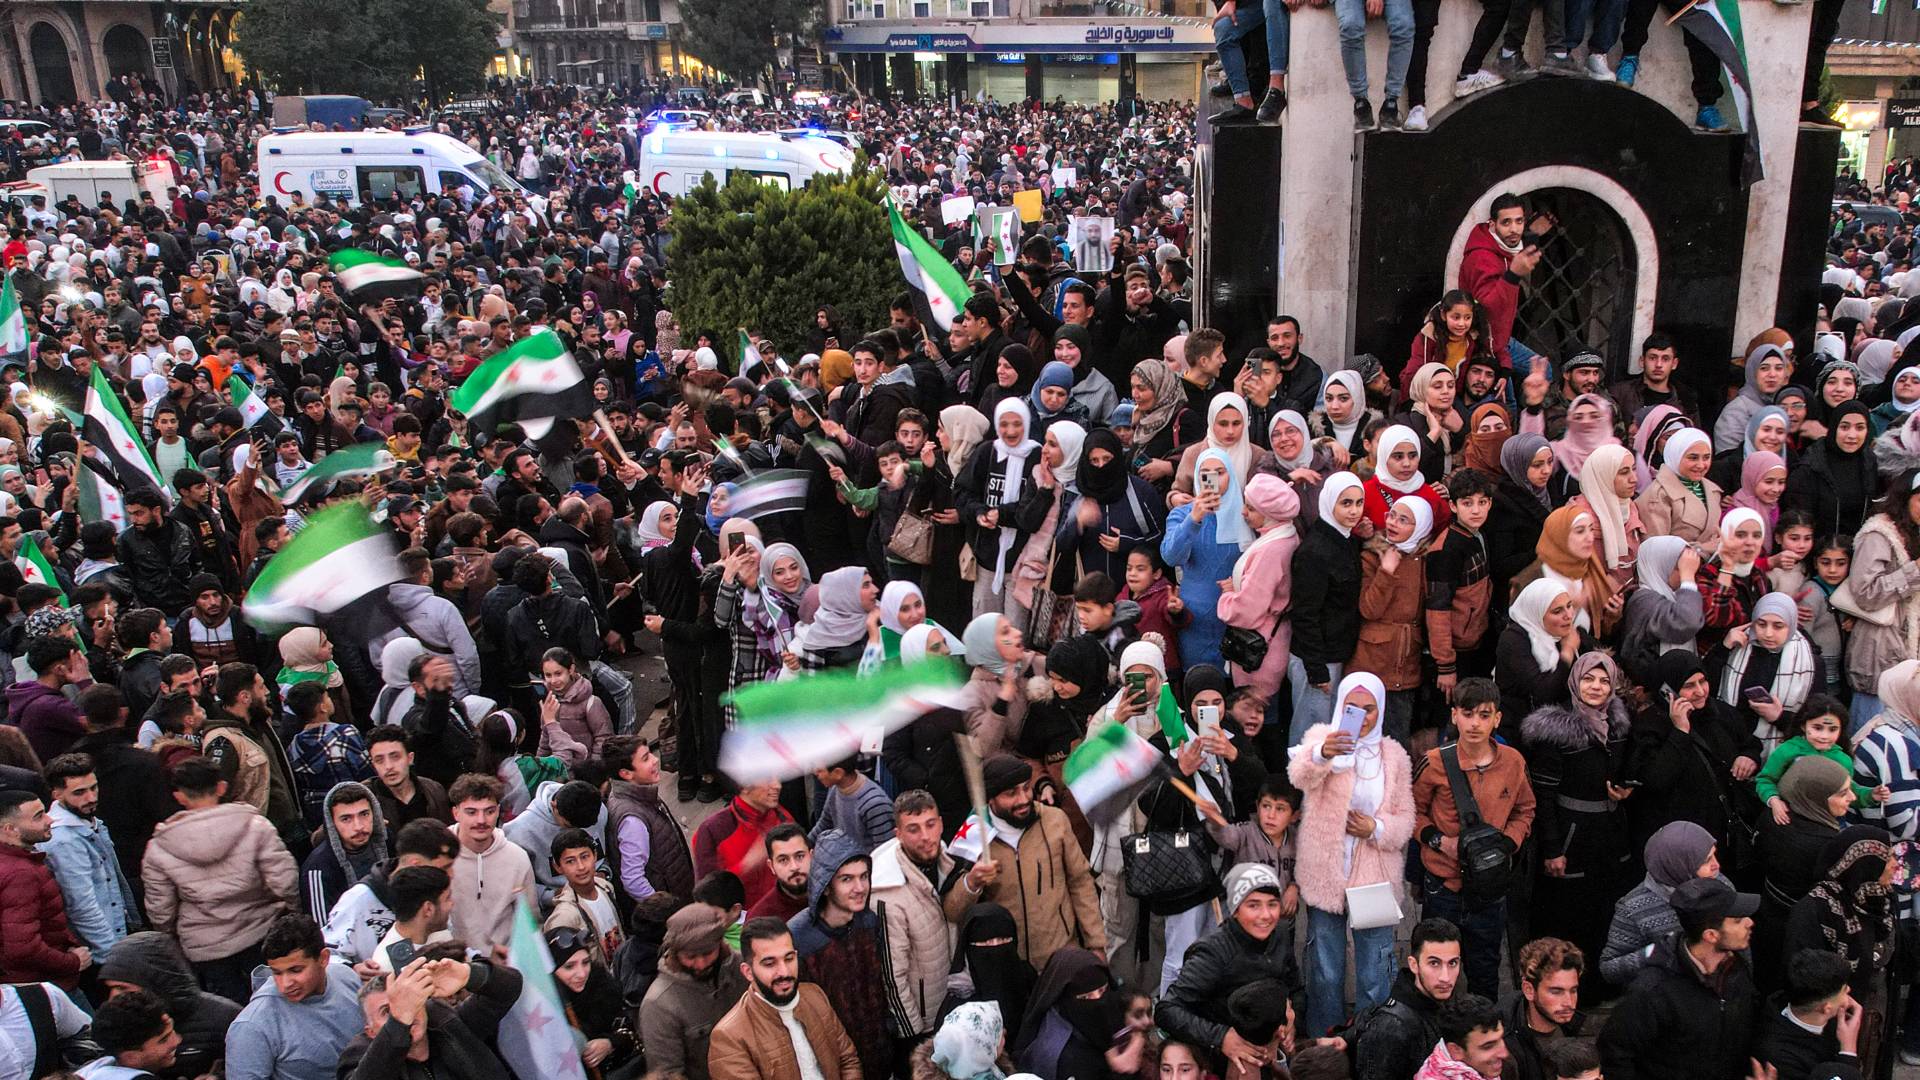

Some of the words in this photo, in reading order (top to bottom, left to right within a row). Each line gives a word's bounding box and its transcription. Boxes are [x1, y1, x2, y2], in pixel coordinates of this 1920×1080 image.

[1085, 26, 1113, 43] الخليج
[1124, 26, 1155, 43] سورية
[1156, 26, 1175, 42] بنك
[996, 52, 1008, 61] Syria
[1009, 52, 1020, 60] Gulf
